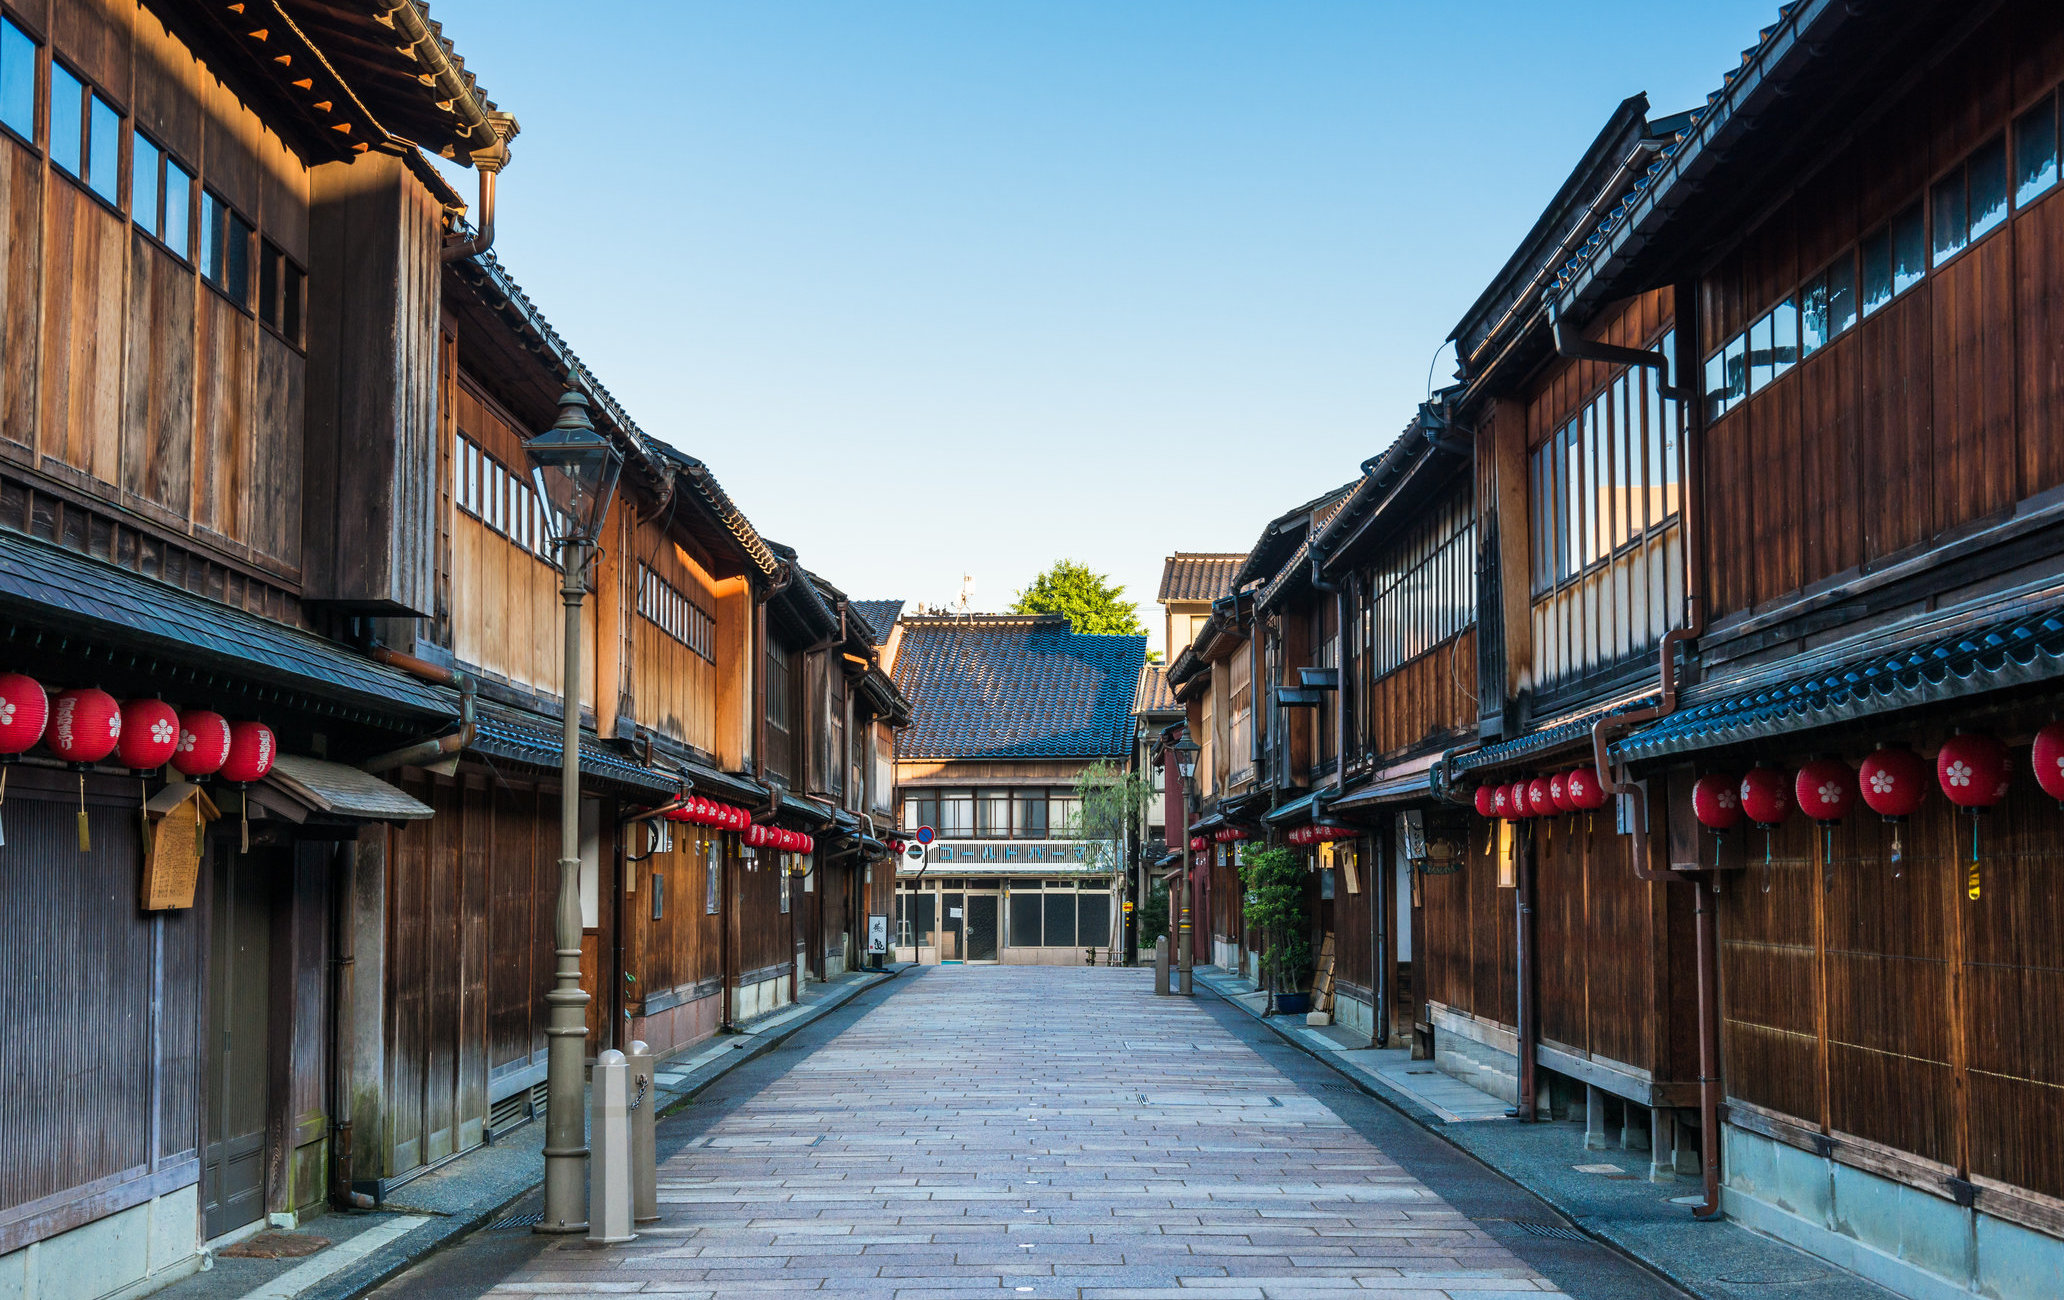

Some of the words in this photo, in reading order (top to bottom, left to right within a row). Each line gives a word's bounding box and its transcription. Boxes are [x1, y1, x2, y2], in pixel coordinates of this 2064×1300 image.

[939, 846, 1087, 861] コールドパーマ
